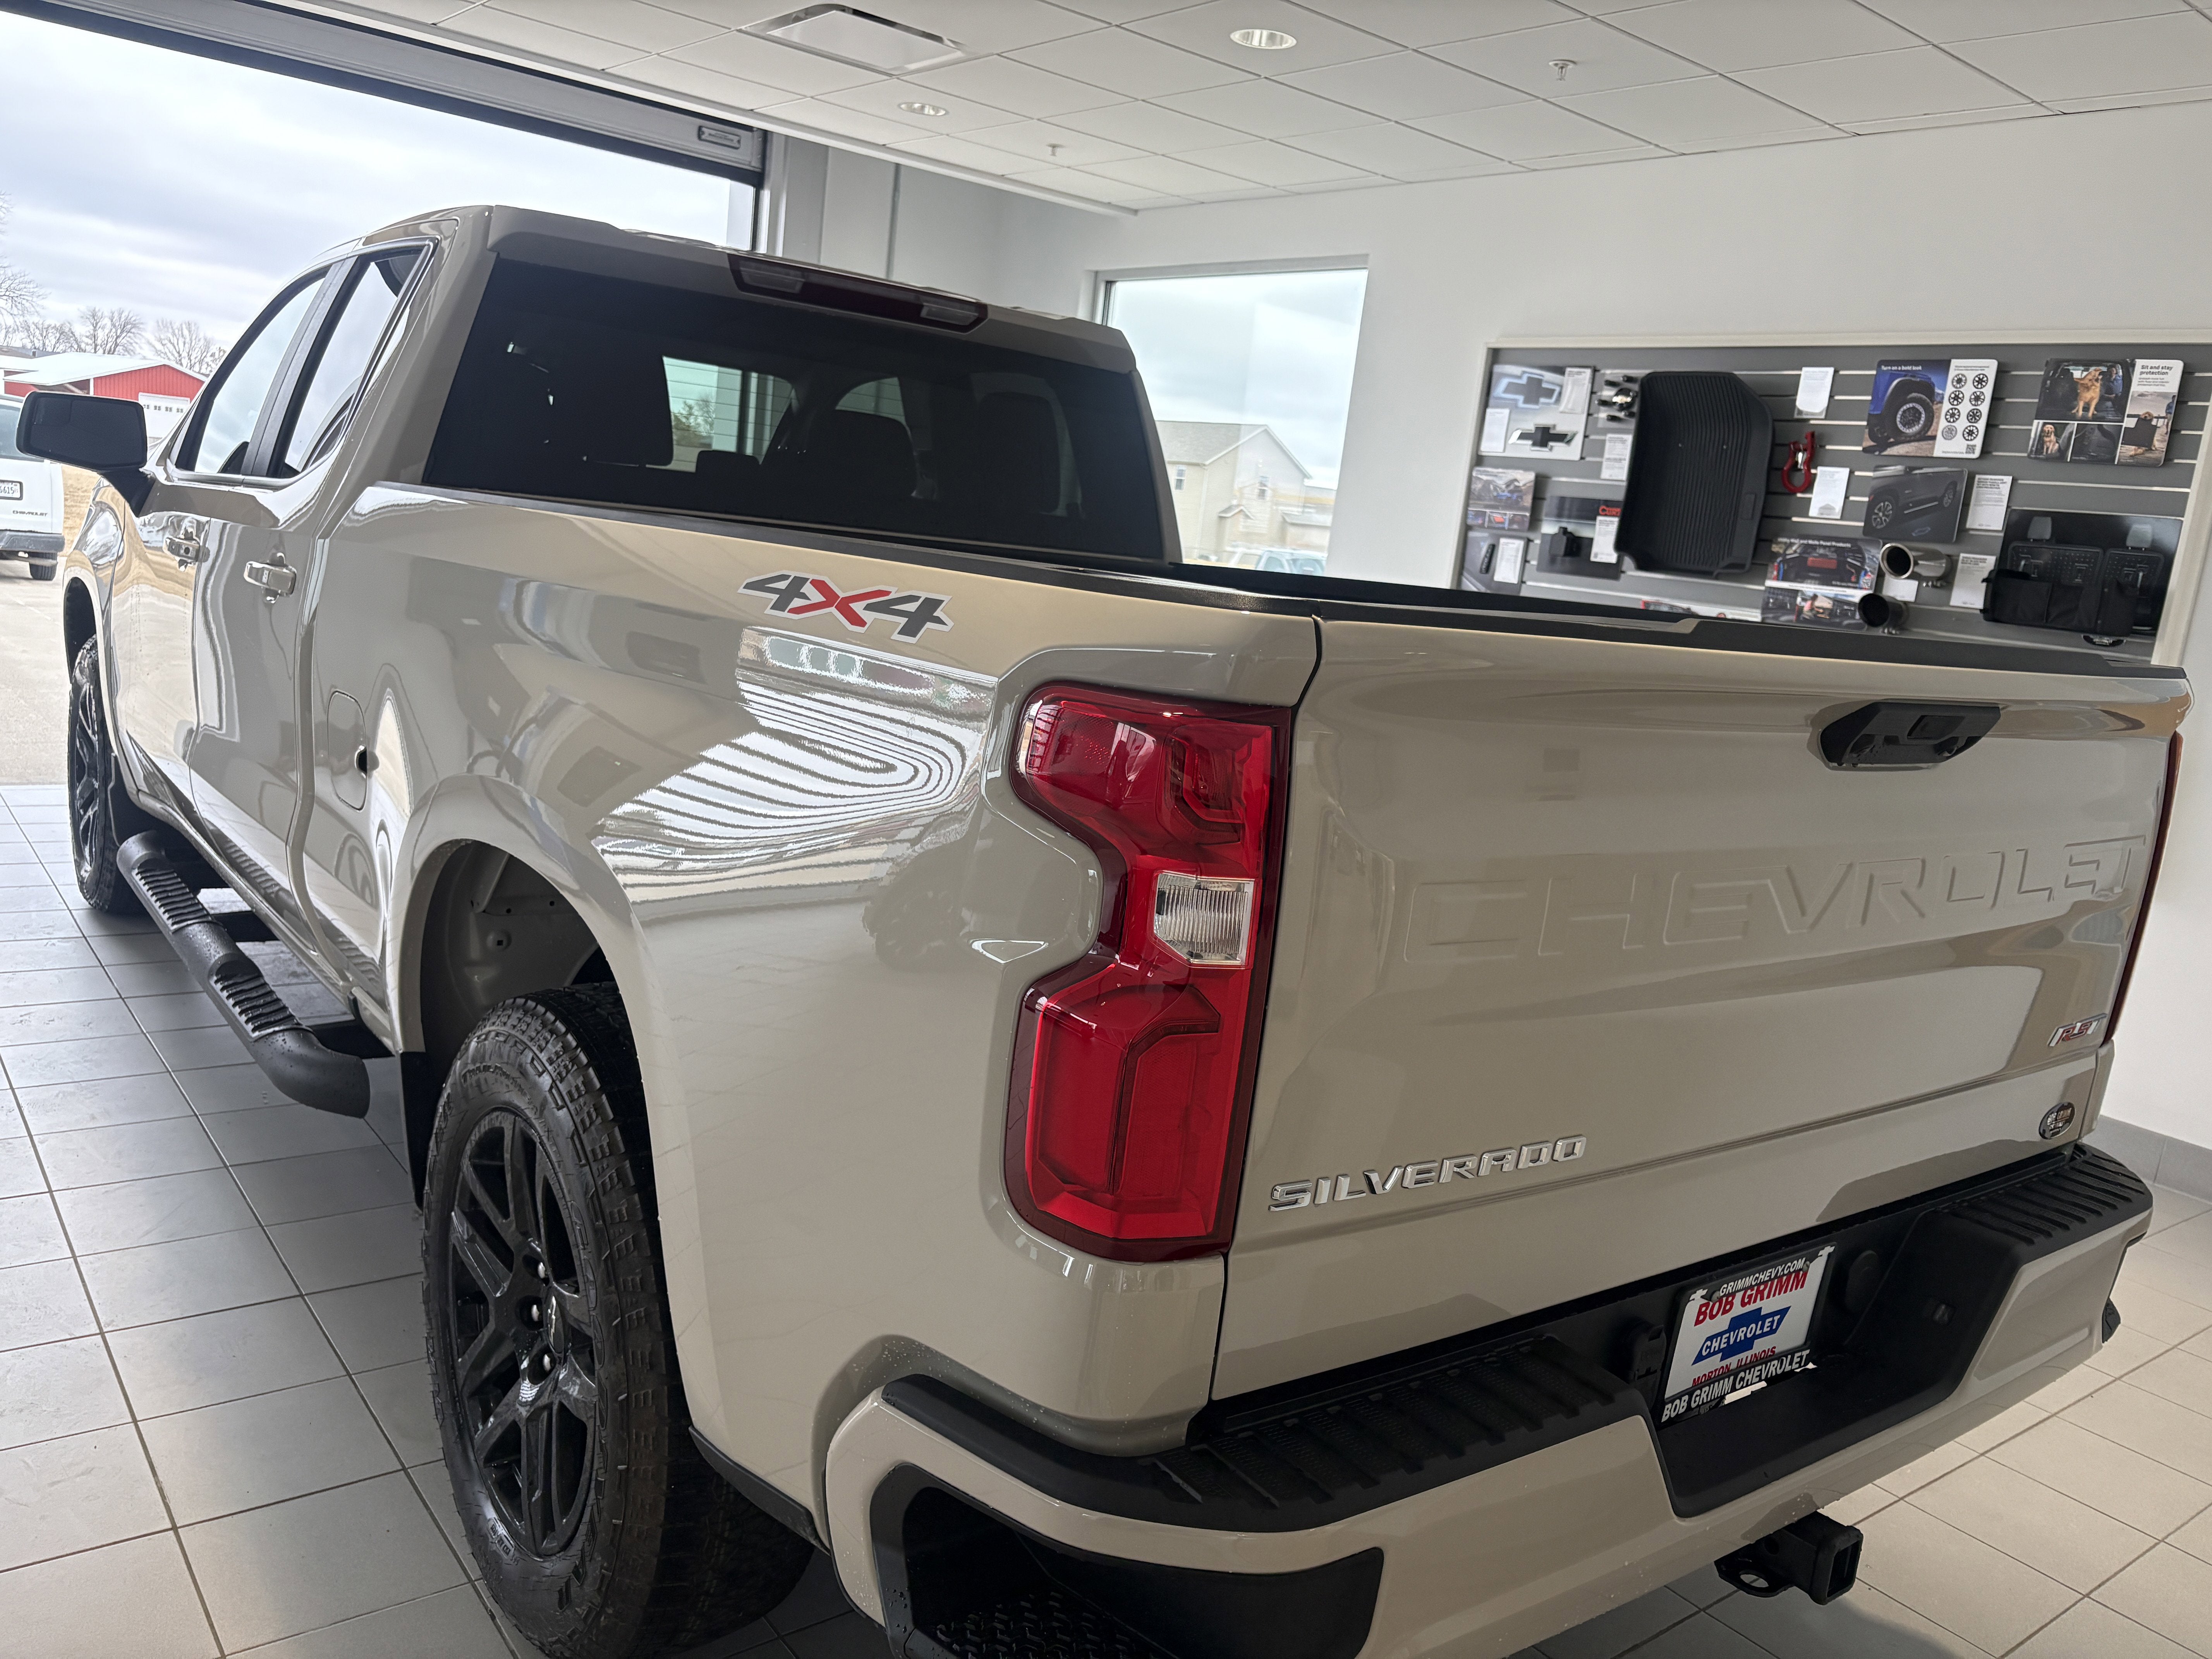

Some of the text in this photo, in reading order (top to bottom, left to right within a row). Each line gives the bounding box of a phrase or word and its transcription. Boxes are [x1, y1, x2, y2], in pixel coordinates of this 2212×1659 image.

[1403, 835, 2147, 963] CHEVROLET
[1268, 1134, 1587, 1212] SILVERADO
[1694, 1270, 1808, 1327] BOB GRIMM
[1719, 1257, 1805, 1296] GRIMMCHEVY.COM
[1701, 1315, 1781, 1356] CHEVROLET
[1736, 1346, 1777, 1369] ILLINOIS
[1661, 1349, 1810, 1423] BOB GRIMM CHEVROLET
